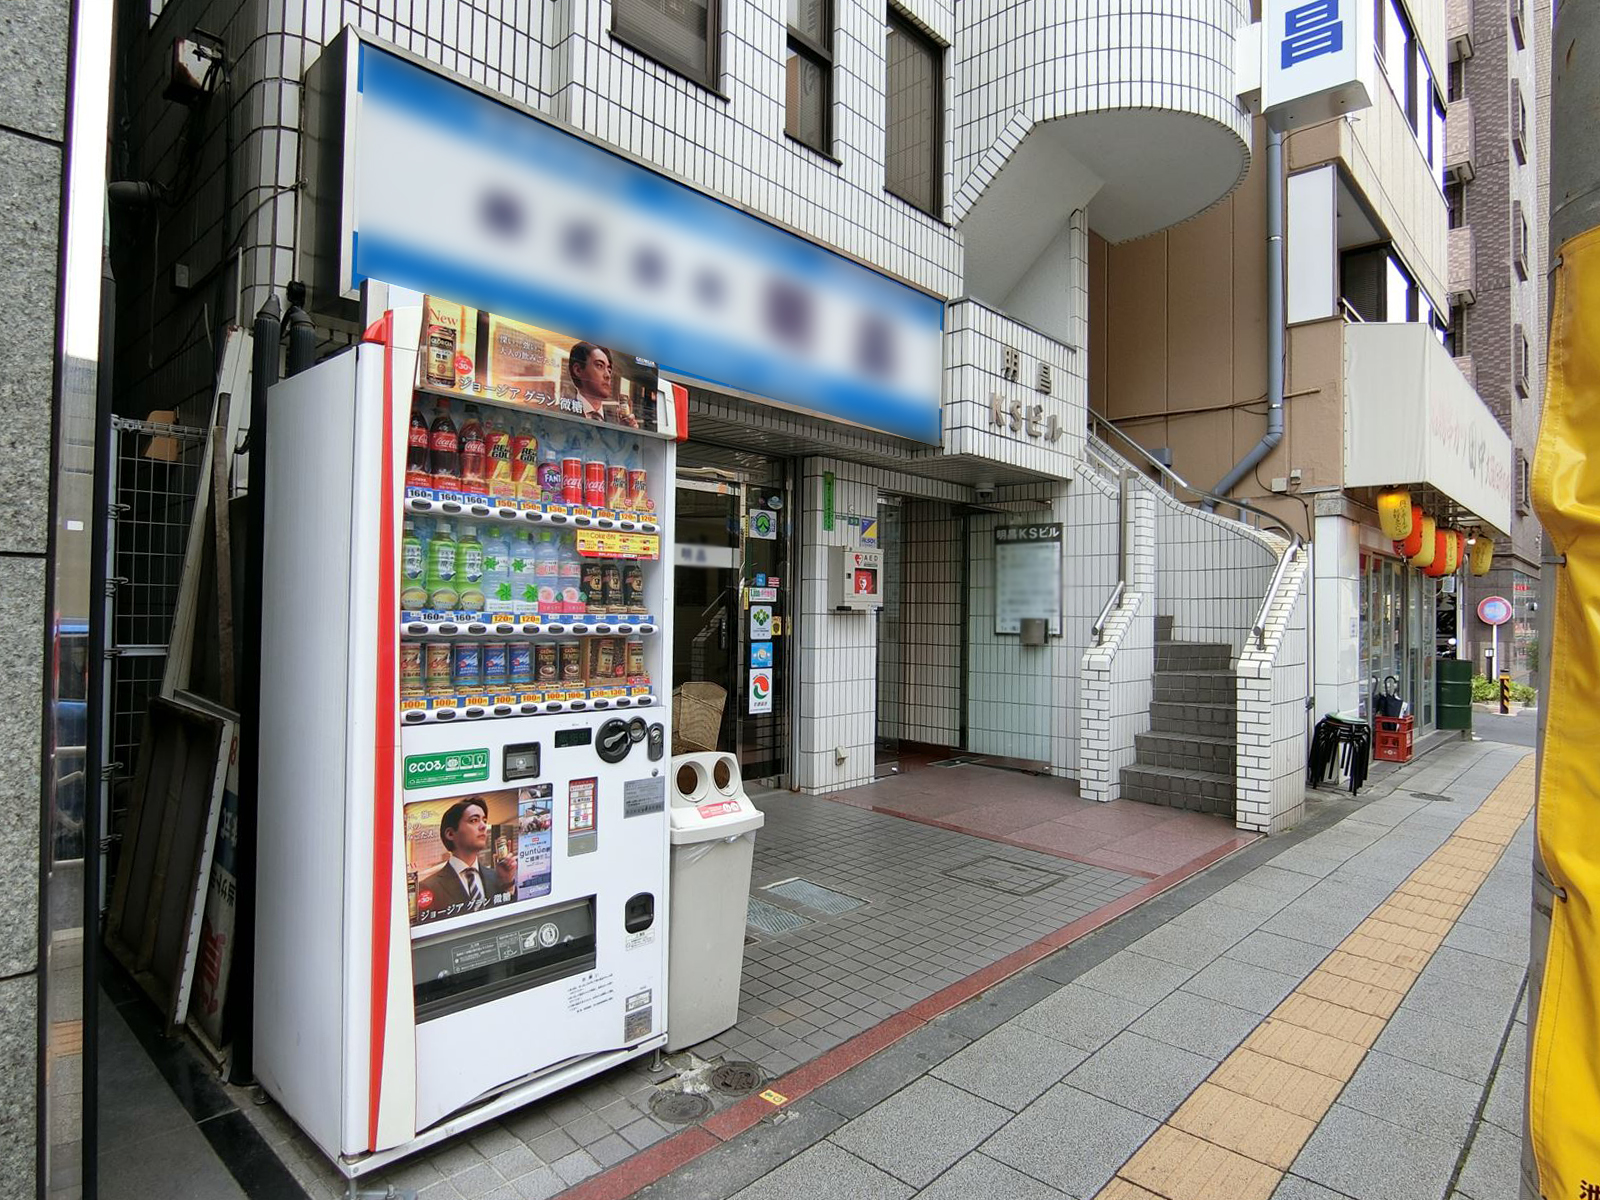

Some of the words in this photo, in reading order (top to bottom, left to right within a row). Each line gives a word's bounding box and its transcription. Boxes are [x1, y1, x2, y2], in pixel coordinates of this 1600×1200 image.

[1281, 0, 1343, 70] 昌
[429, 307, 458, 326] New
[460, 377, 520, 399] ジョージア
[524, 391, 557, 407] グラン
[989, 392, 1063, 443] KSビル
[864, 554, 878, 562] AED
[421, 903, 464, 920] ジョージア
[467, 898, 491, 911] グラン
